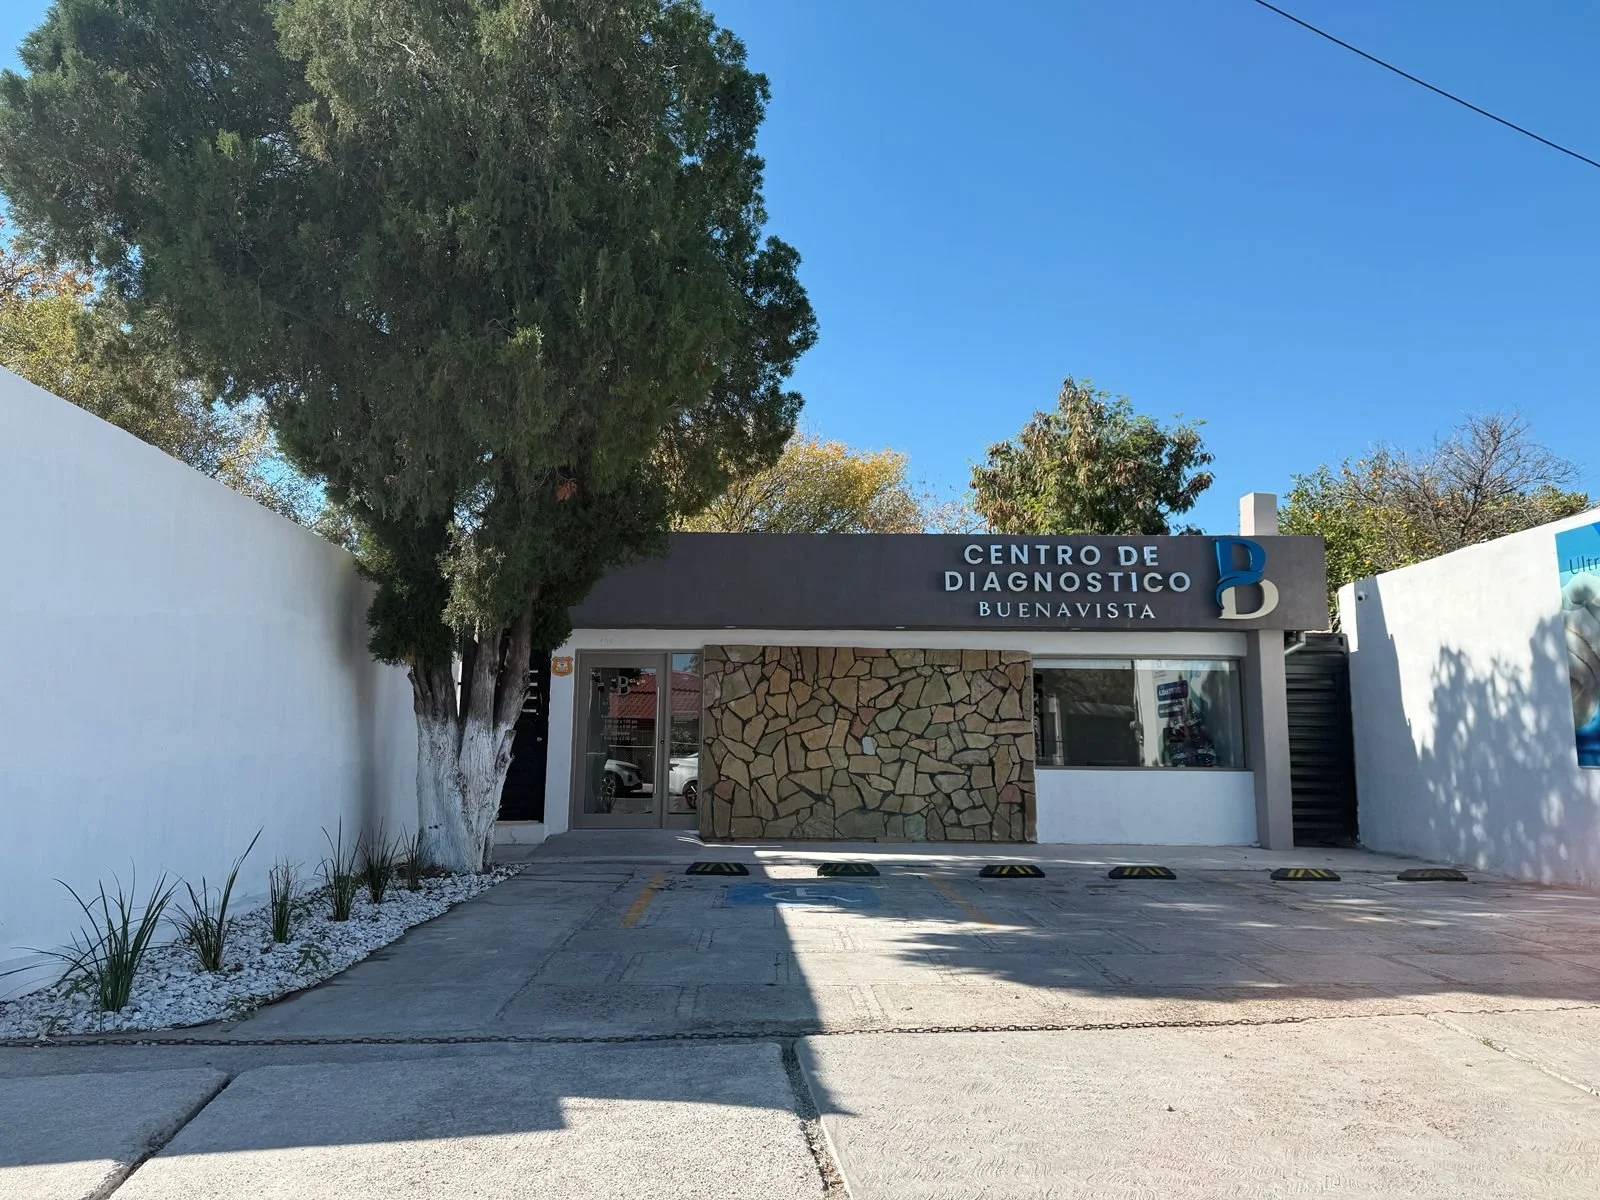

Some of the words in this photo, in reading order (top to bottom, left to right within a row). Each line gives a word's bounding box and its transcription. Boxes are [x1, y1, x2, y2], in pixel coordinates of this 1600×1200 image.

[963, 544, 1101, 566] CENTRO
[1117, 545, 1159, 567] DE
[1569, 555, 1600, 575] Ultr
[944, 571, 1191, 593] DIAGNOSTICO
[978, 601, 1157, 619] BUENAVISTA
